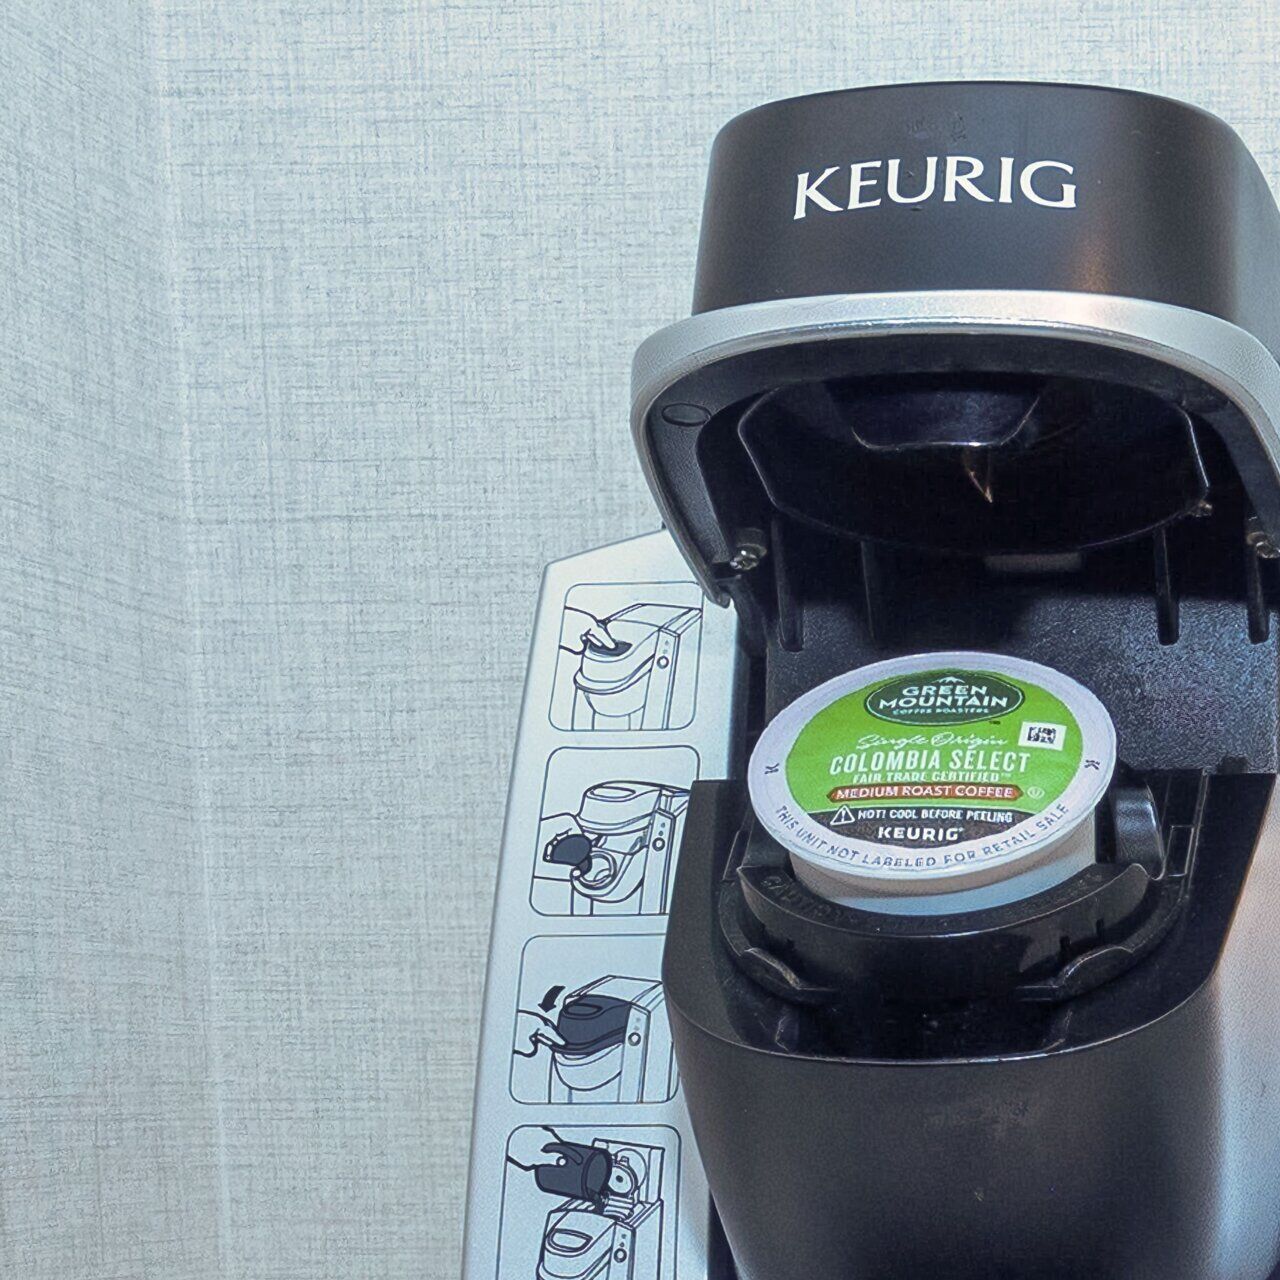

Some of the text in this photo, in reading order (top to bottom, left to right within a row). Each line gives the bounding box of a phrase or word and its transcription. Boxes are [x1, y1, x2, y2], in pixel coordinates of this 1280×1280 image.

[793, 155, 1077, 220] KEURIG
[902, 685, 987, 696] GREEN
[878, 696, 1008, 710] MOUNTAIN
[829, 750, 1031, 775] COLOMBIA SELECT
[836, 785, 1014, 799] MEDIUM ROAST COFFEE
[775, 804, 800, 831] THIS
[796, 827, 828, 850] UNIT
[826, 844, 860, 862] NOT
[943, 850, 977, 865] FOR
[981, 830, 1037, 856] RETAIL
[1035, 802, 1070, 831] SALE
[878, 825, 959, 841] KEURIG
